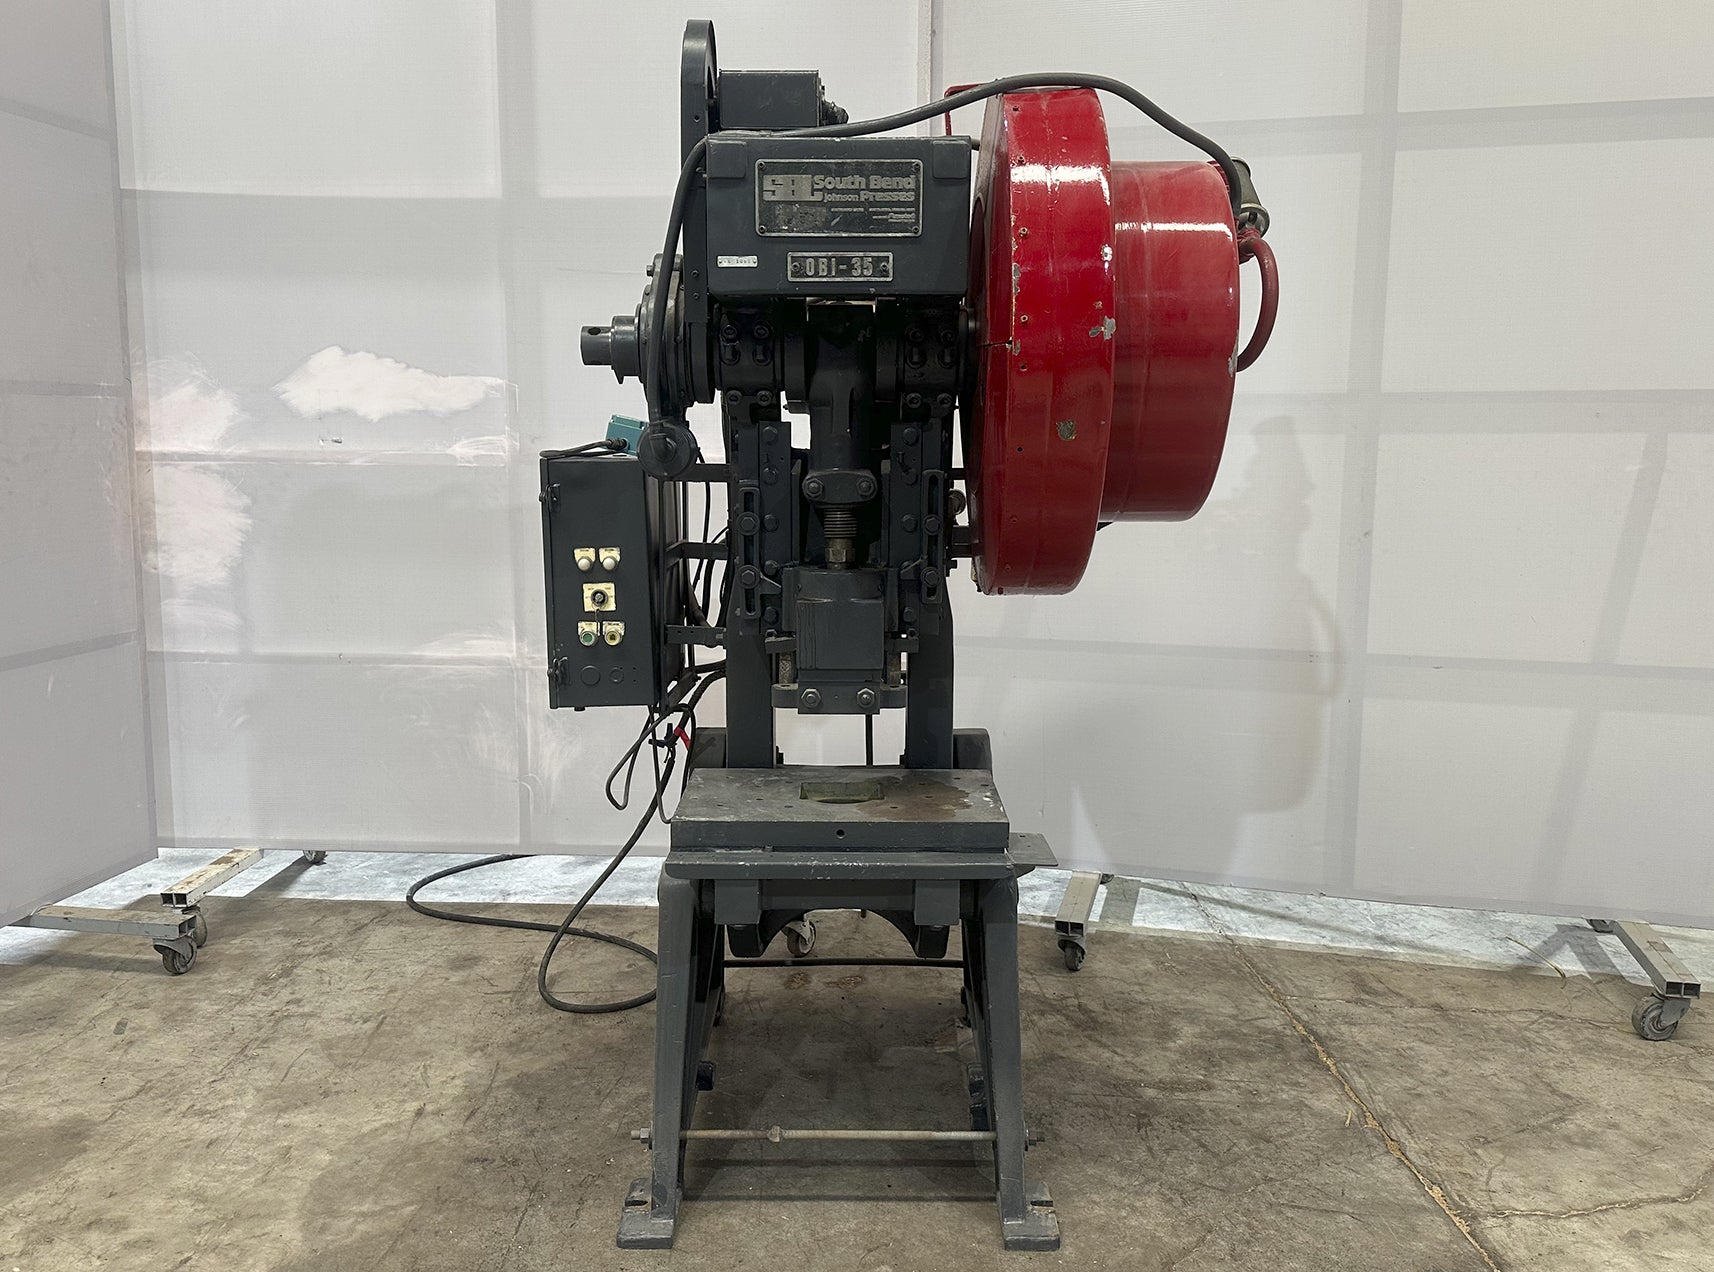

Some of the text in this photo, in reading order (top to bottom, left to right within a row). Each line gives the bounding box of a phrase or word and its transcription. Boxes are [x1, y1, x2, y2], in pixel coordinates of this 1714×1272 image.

[813, 174, 915, 189] South Bend
[860, 191, 915, 202] Presses
